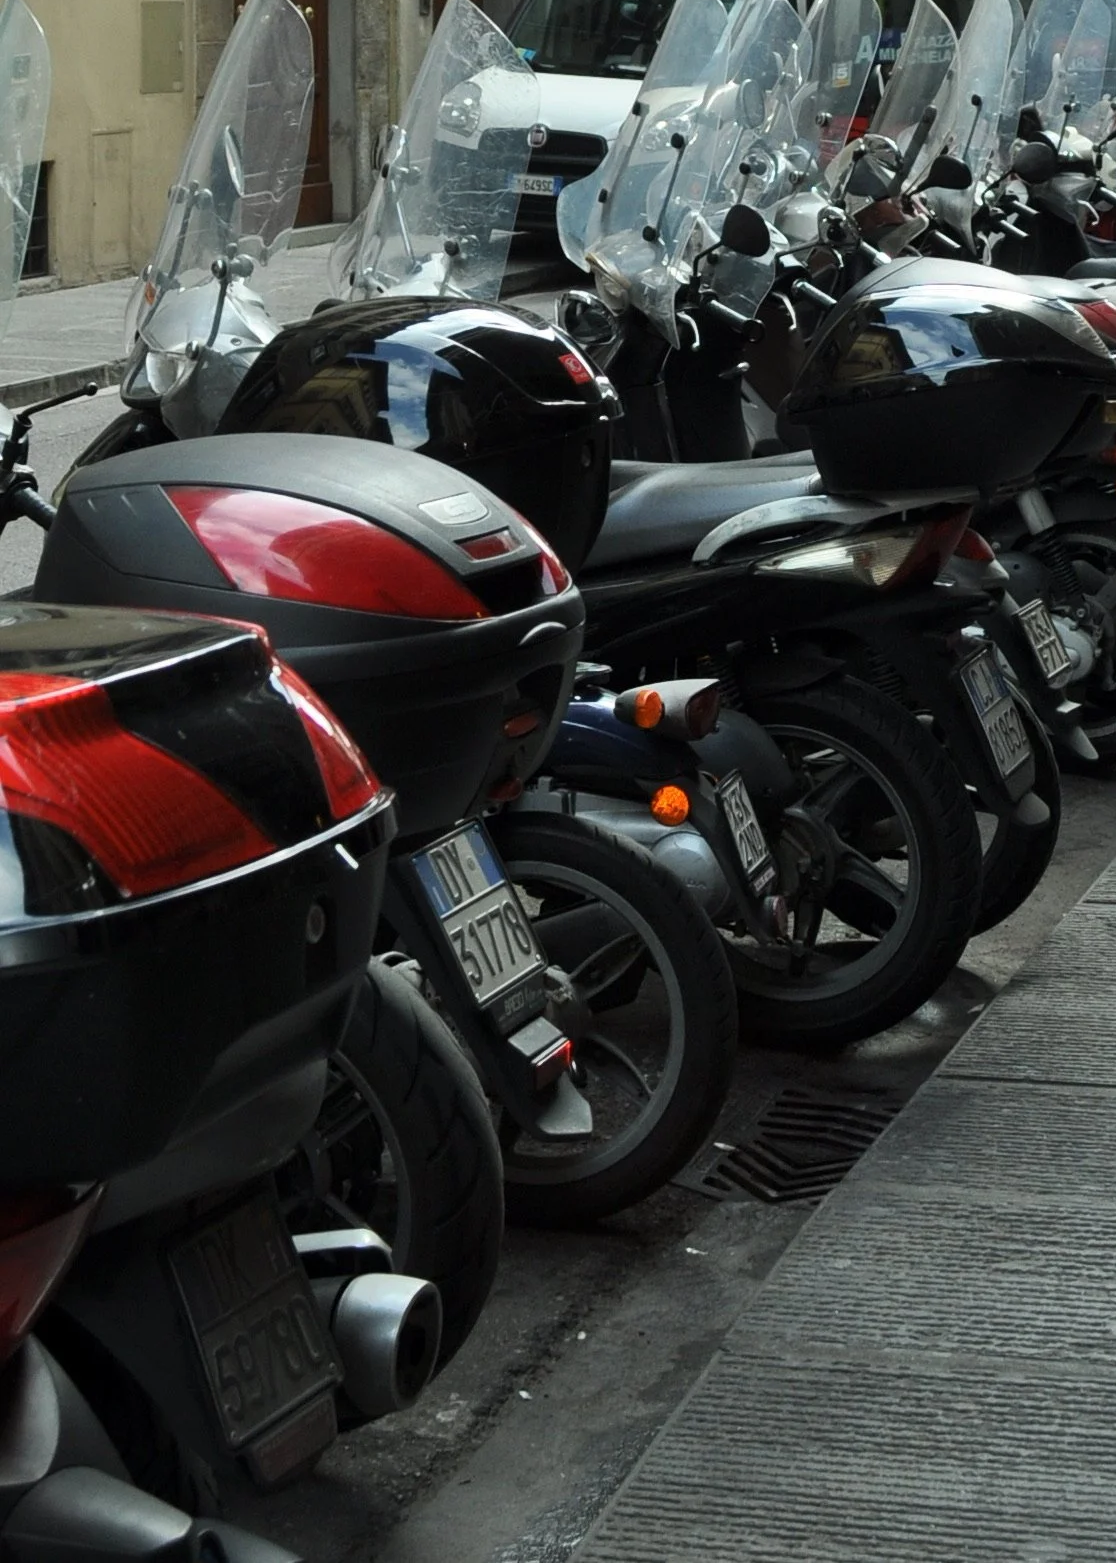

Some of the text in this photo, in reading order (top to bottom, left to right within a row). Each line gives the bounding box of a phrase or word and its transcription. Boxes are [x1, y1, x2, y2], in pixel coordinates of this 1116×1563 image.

[986, 706, 1029, 766] 81852
[427, 839, 476, 905] DY
[449, 900, 534, 986] 31778
[211, 1295, 324, 1421] 59780
